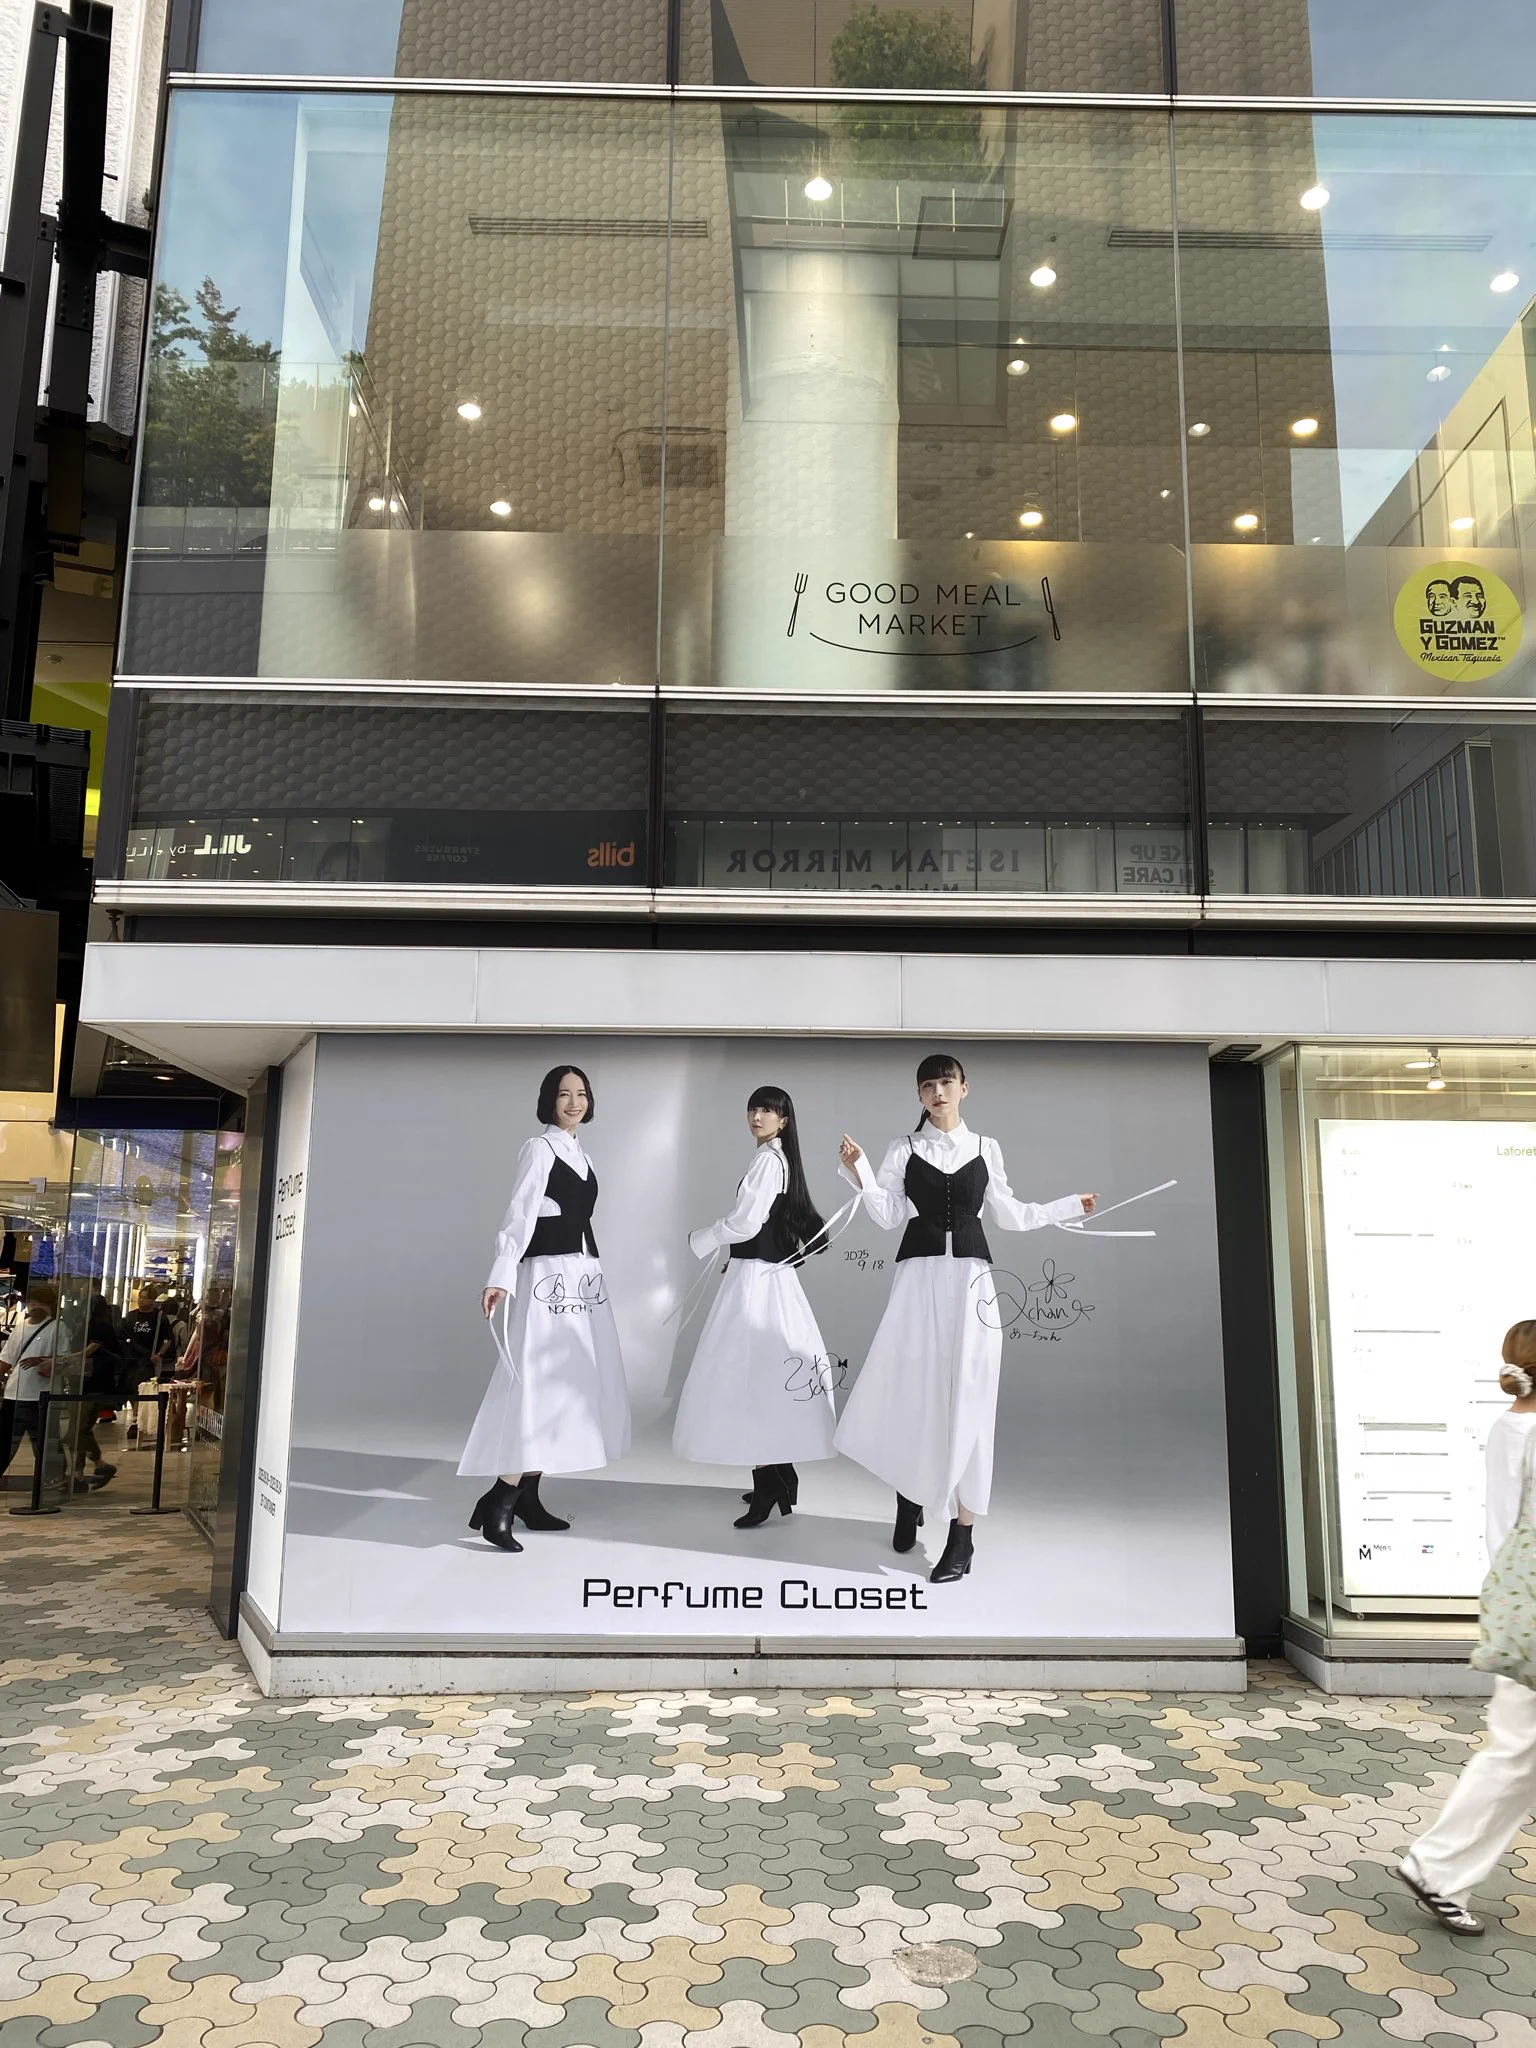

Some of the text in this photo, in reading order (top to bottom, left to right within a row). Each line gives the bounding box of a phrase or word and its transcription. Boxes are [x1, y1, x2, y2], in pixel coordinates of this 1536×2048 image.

[825, 582, 1021, 606] GOOD MEAL
[858, 613, 988, 637] MARKET
[1419, 618, 1496, 635] GUZMAN
[1419, 636, 1433, 651] Y
[1420, 652, 1460, 662] Mexican
[843, 1249, 870, 1262] 2025
[857, 1259, 885, 1271] 9 18
[583, 1578, 928, 1610] Perfume Closet
